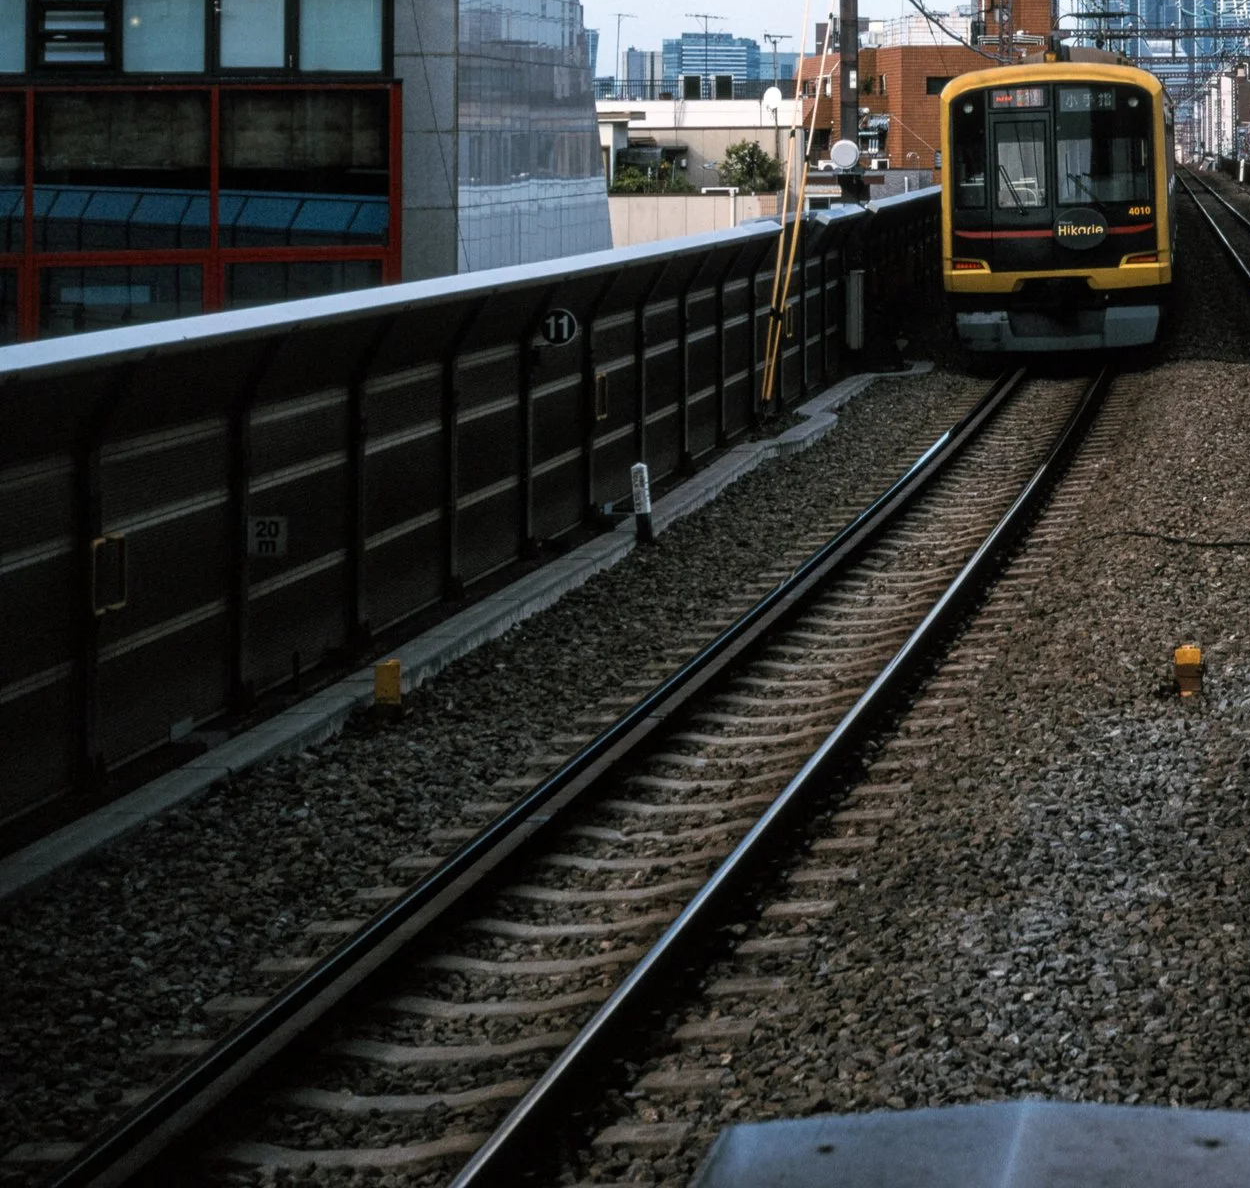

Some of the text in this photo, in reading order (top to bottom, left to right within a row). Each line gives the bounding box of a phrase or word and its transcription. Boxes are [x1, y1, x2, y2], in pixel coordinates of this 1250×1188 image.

[1065, 93, 1113, 109] 小手指
[1128, 206, 1151, 216] 4010
[1058, 224, 1104, 236] Hikarie
[545, 315, 569, 339] 11
[254, 520, 279, 538] 20
[258, 540, 277, 553] m
